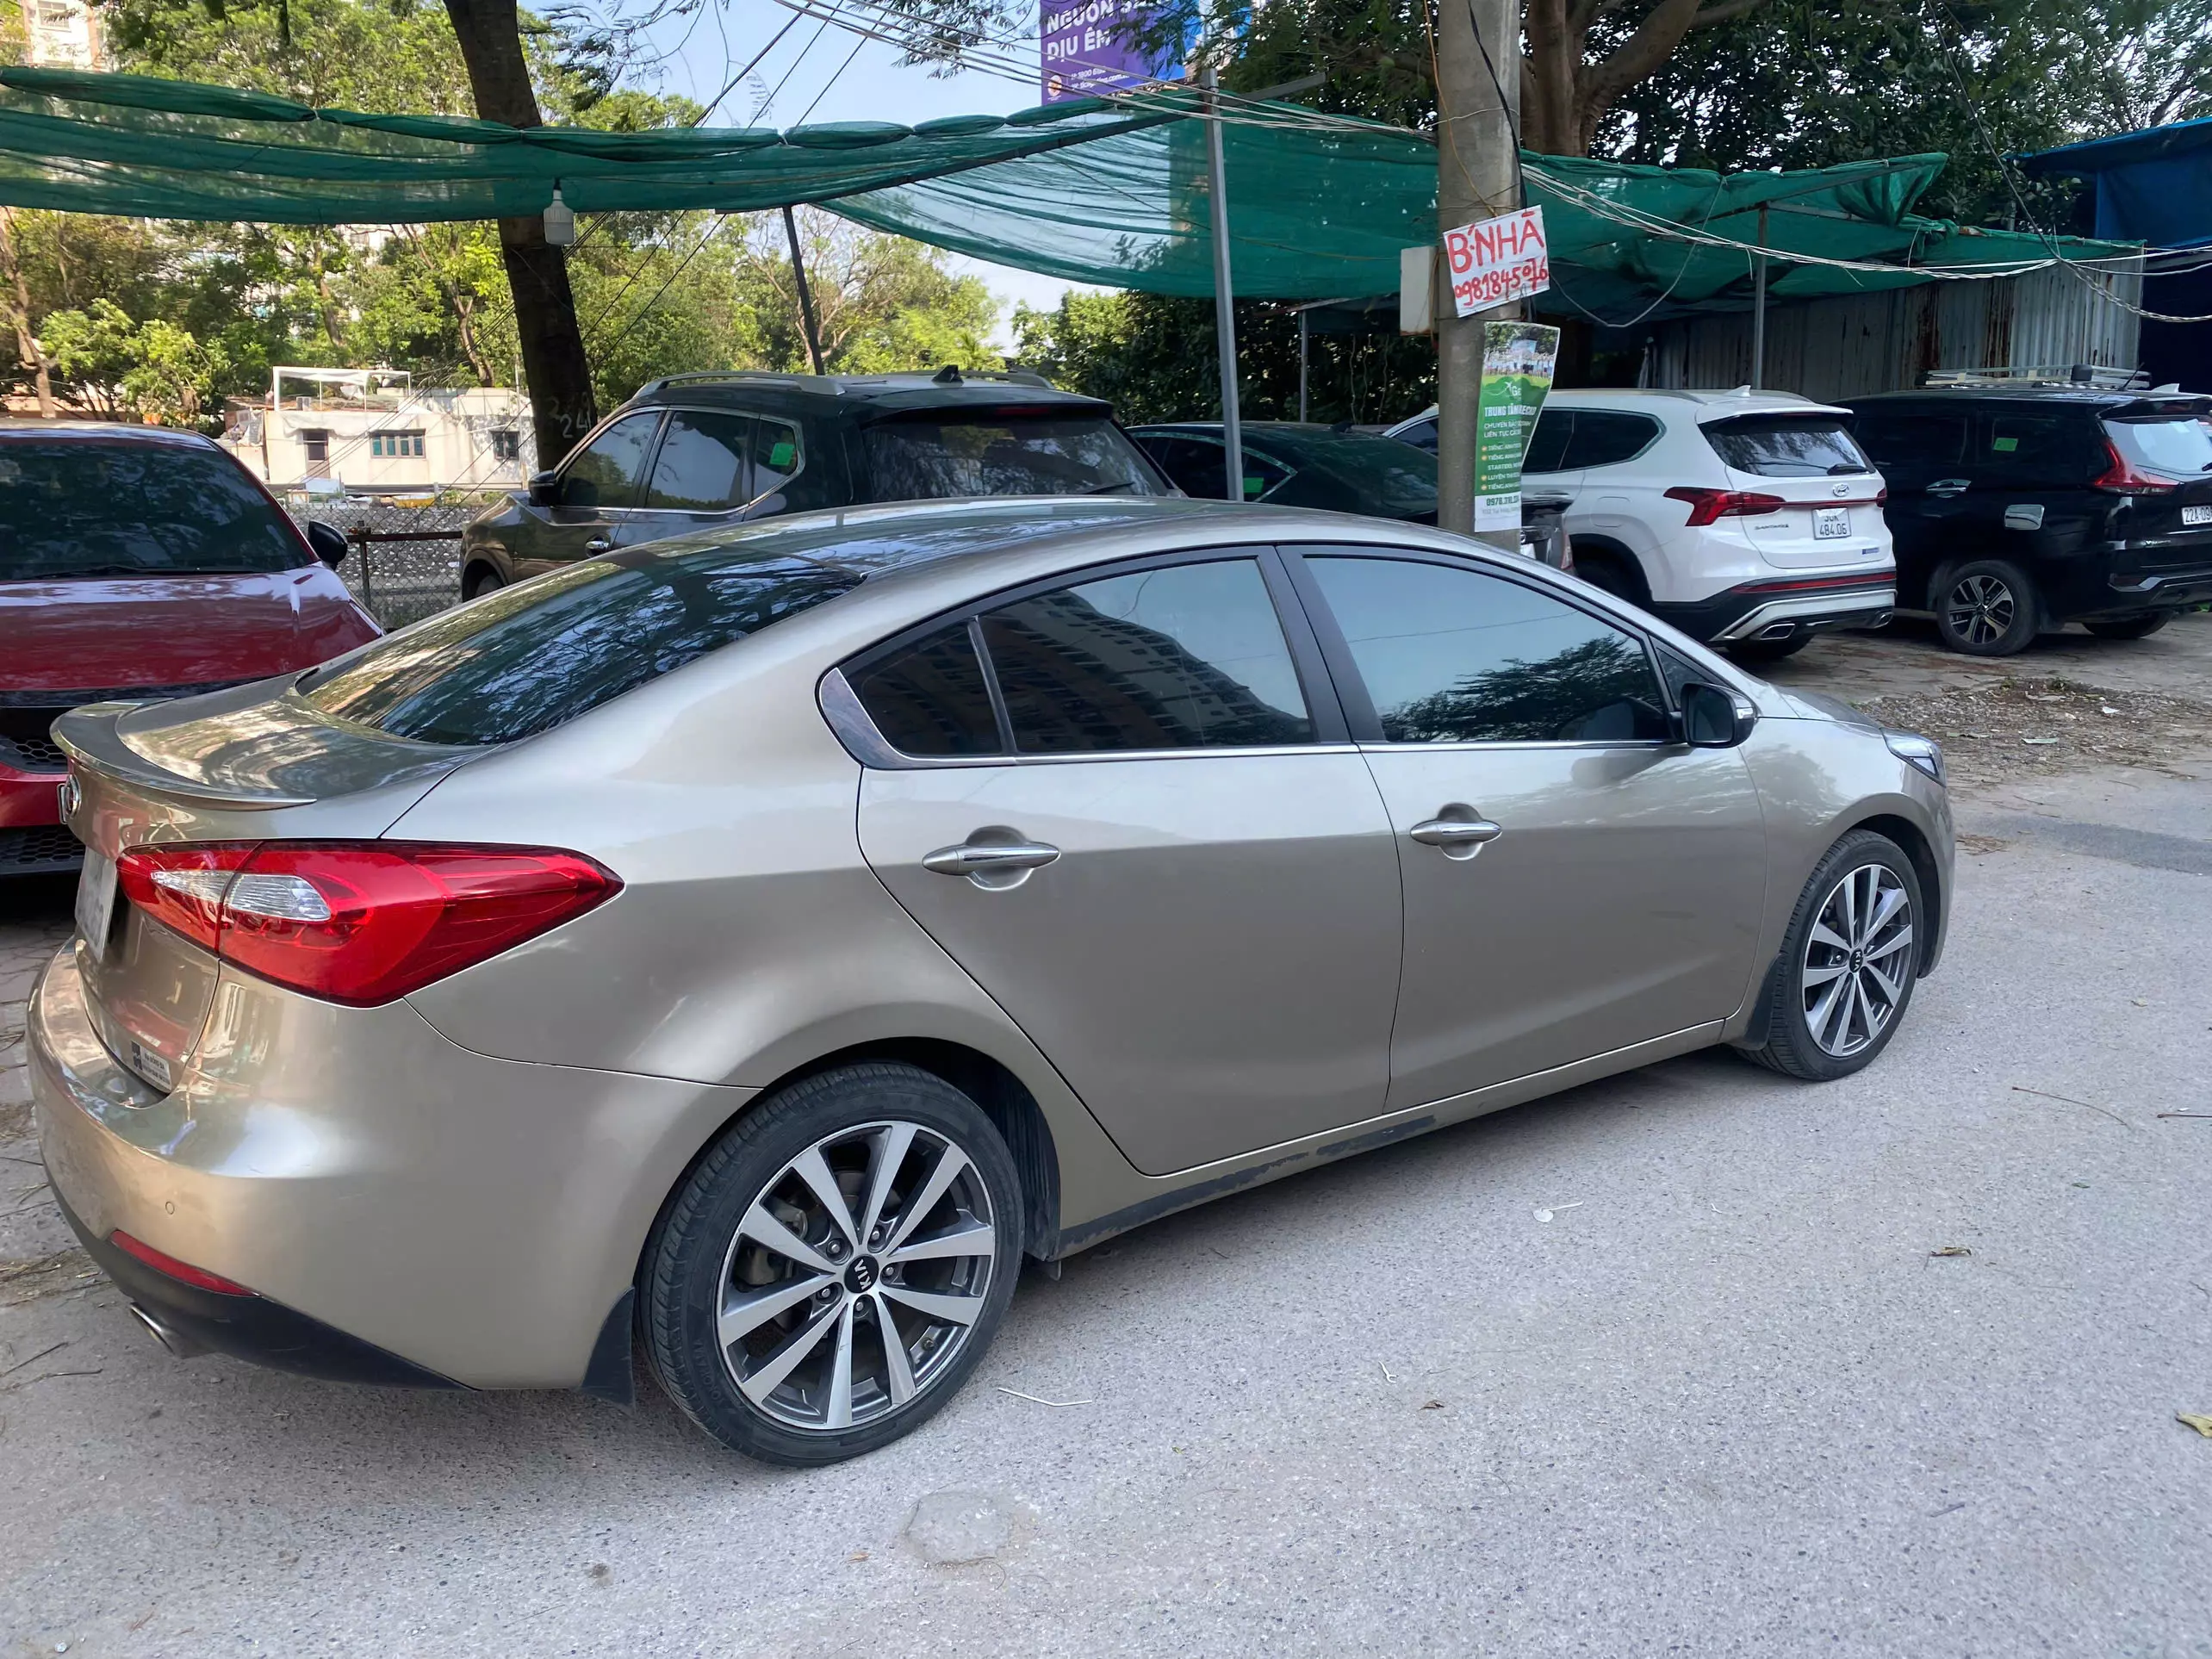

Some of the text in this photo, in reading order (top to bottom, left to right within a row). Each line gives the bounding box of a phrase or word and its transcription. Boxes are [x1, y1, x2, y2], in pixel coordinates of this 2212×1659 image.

[1047, 35, 1078, 62] DỊU
[1454, 256, 1548, 306] 0981845076
[1484, 406, 1506, 417] TRUNG
[1819, 523, 1848, 536] 484.06
[854, 1258, 872, 1290] KIA
